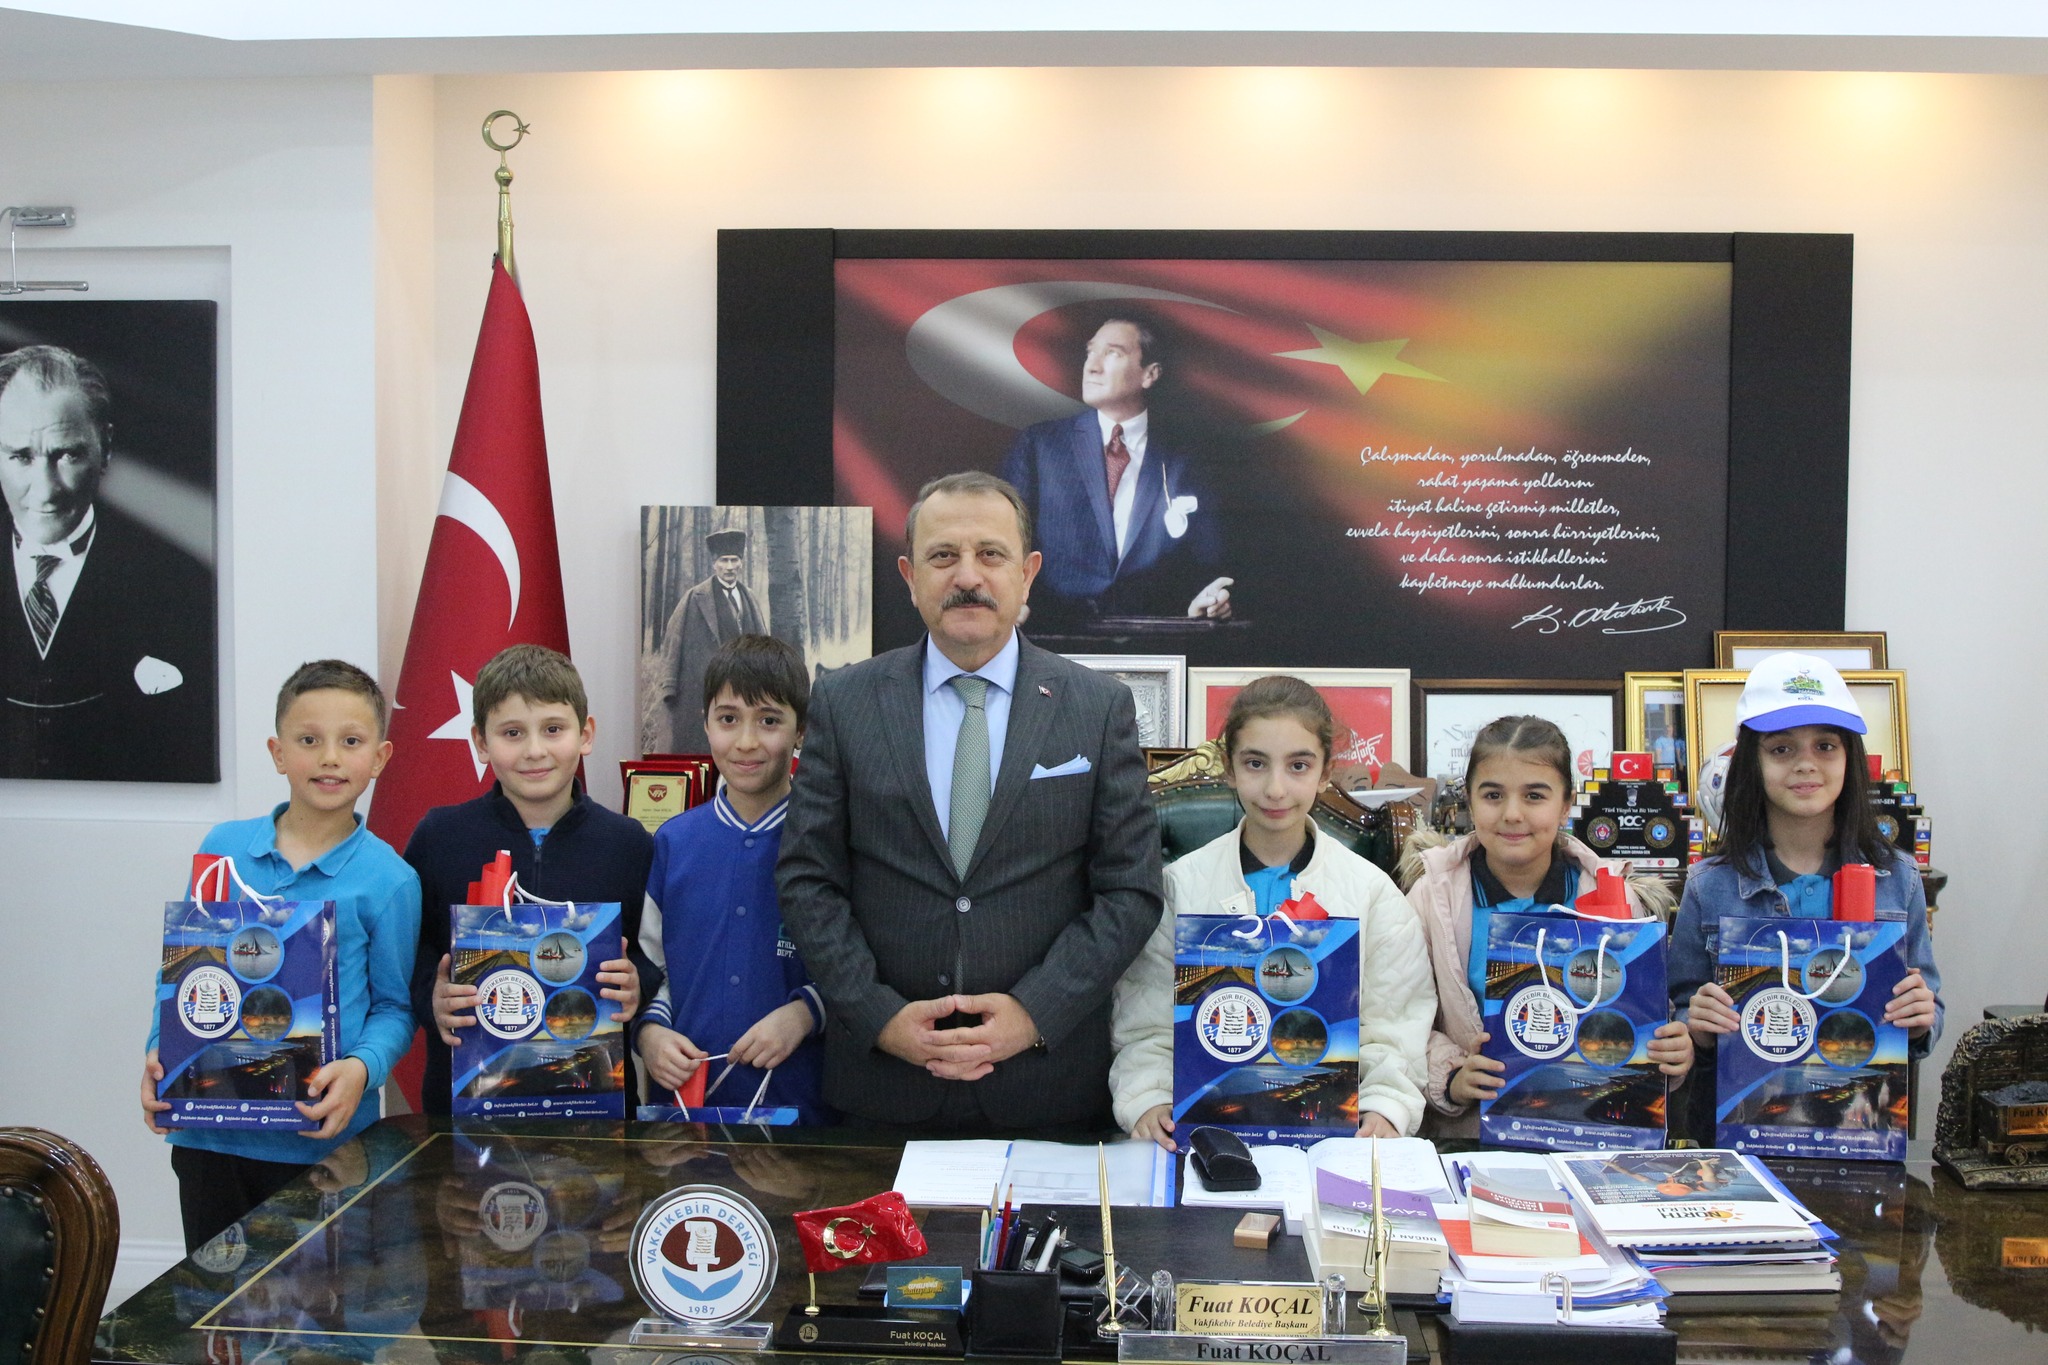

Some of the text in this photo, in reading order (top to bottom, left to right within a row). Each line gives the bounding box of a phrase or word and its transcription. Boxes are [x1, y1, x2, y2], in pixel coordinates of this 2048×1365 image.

[1361, 447, 1651, 468] Çalışmadan, yorulmadan, öğrenmeden,
[1418, 473, 1594, 492] rahat yaşama yollarını
[1387, 498, 1620, 518] itiyat haline getirmiş milletler,
[1346, 524, 1660, 545] evvela haysiyetlerini, sonra hürriyetlerini,
[1400, 549, 1607, 566] ve daha sonra istikballerini
[1400, 574, 1604, 594] kaybetmeye mahkumdurlar.
[648, 1201, 761, 1267] VAKFIKEBİR DERNEĞİ
[688, 1305, 715, 1315] 1987
[1188, 1296, 1313, 1318] Fuat KOÇAL
[1193, 1318, 1308, 1329] Vakfıkebir Belediye Başkanı
[890, 1331, 946, 1341] Fuat KOÇAL
[1197, 1343, 1330, 1364] Fuat KOÇAL
